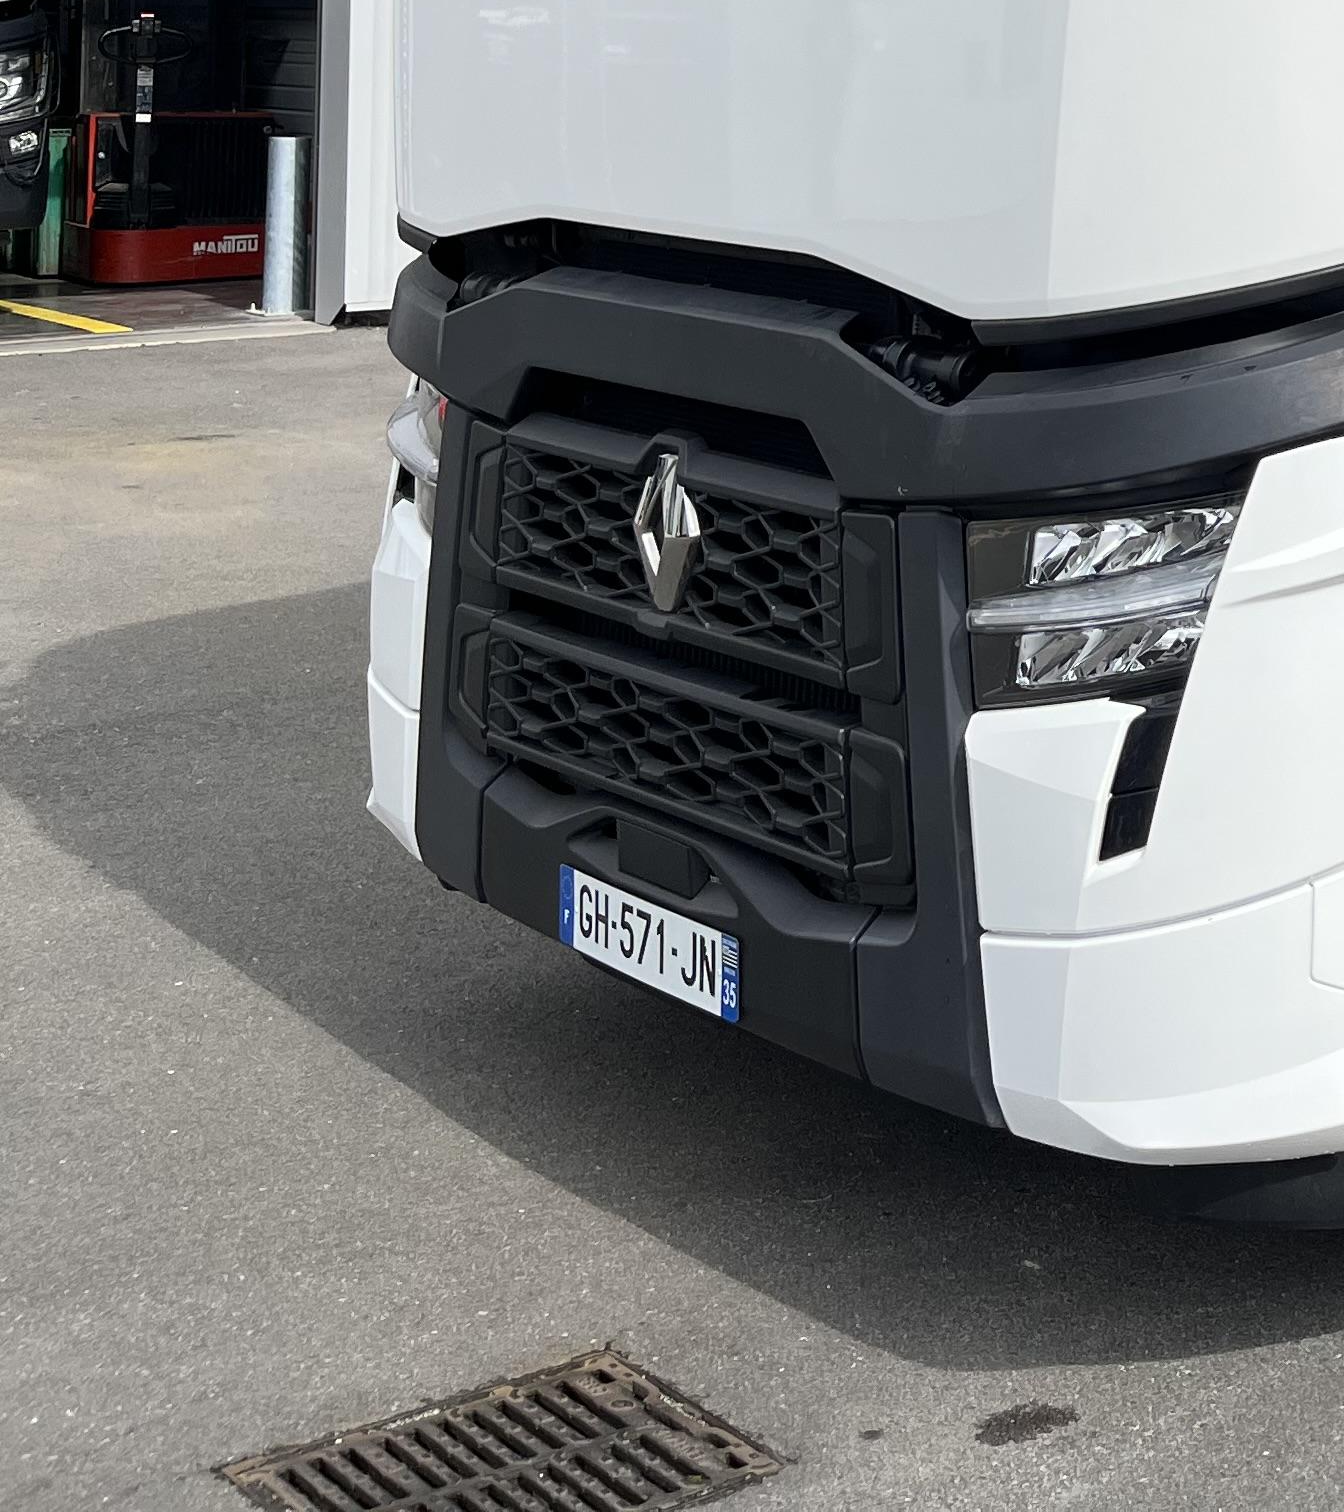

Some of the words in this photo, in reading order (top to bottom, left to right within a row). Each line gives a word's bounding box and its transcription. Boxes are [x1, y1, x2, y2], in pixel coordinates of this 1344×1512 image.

[193, 233, 259, 255] MANITOU
[563, 908, 571, 925] F
[579, 884, 717, 998] GH-571-JN
[722, 978, 738, 1009] 35
